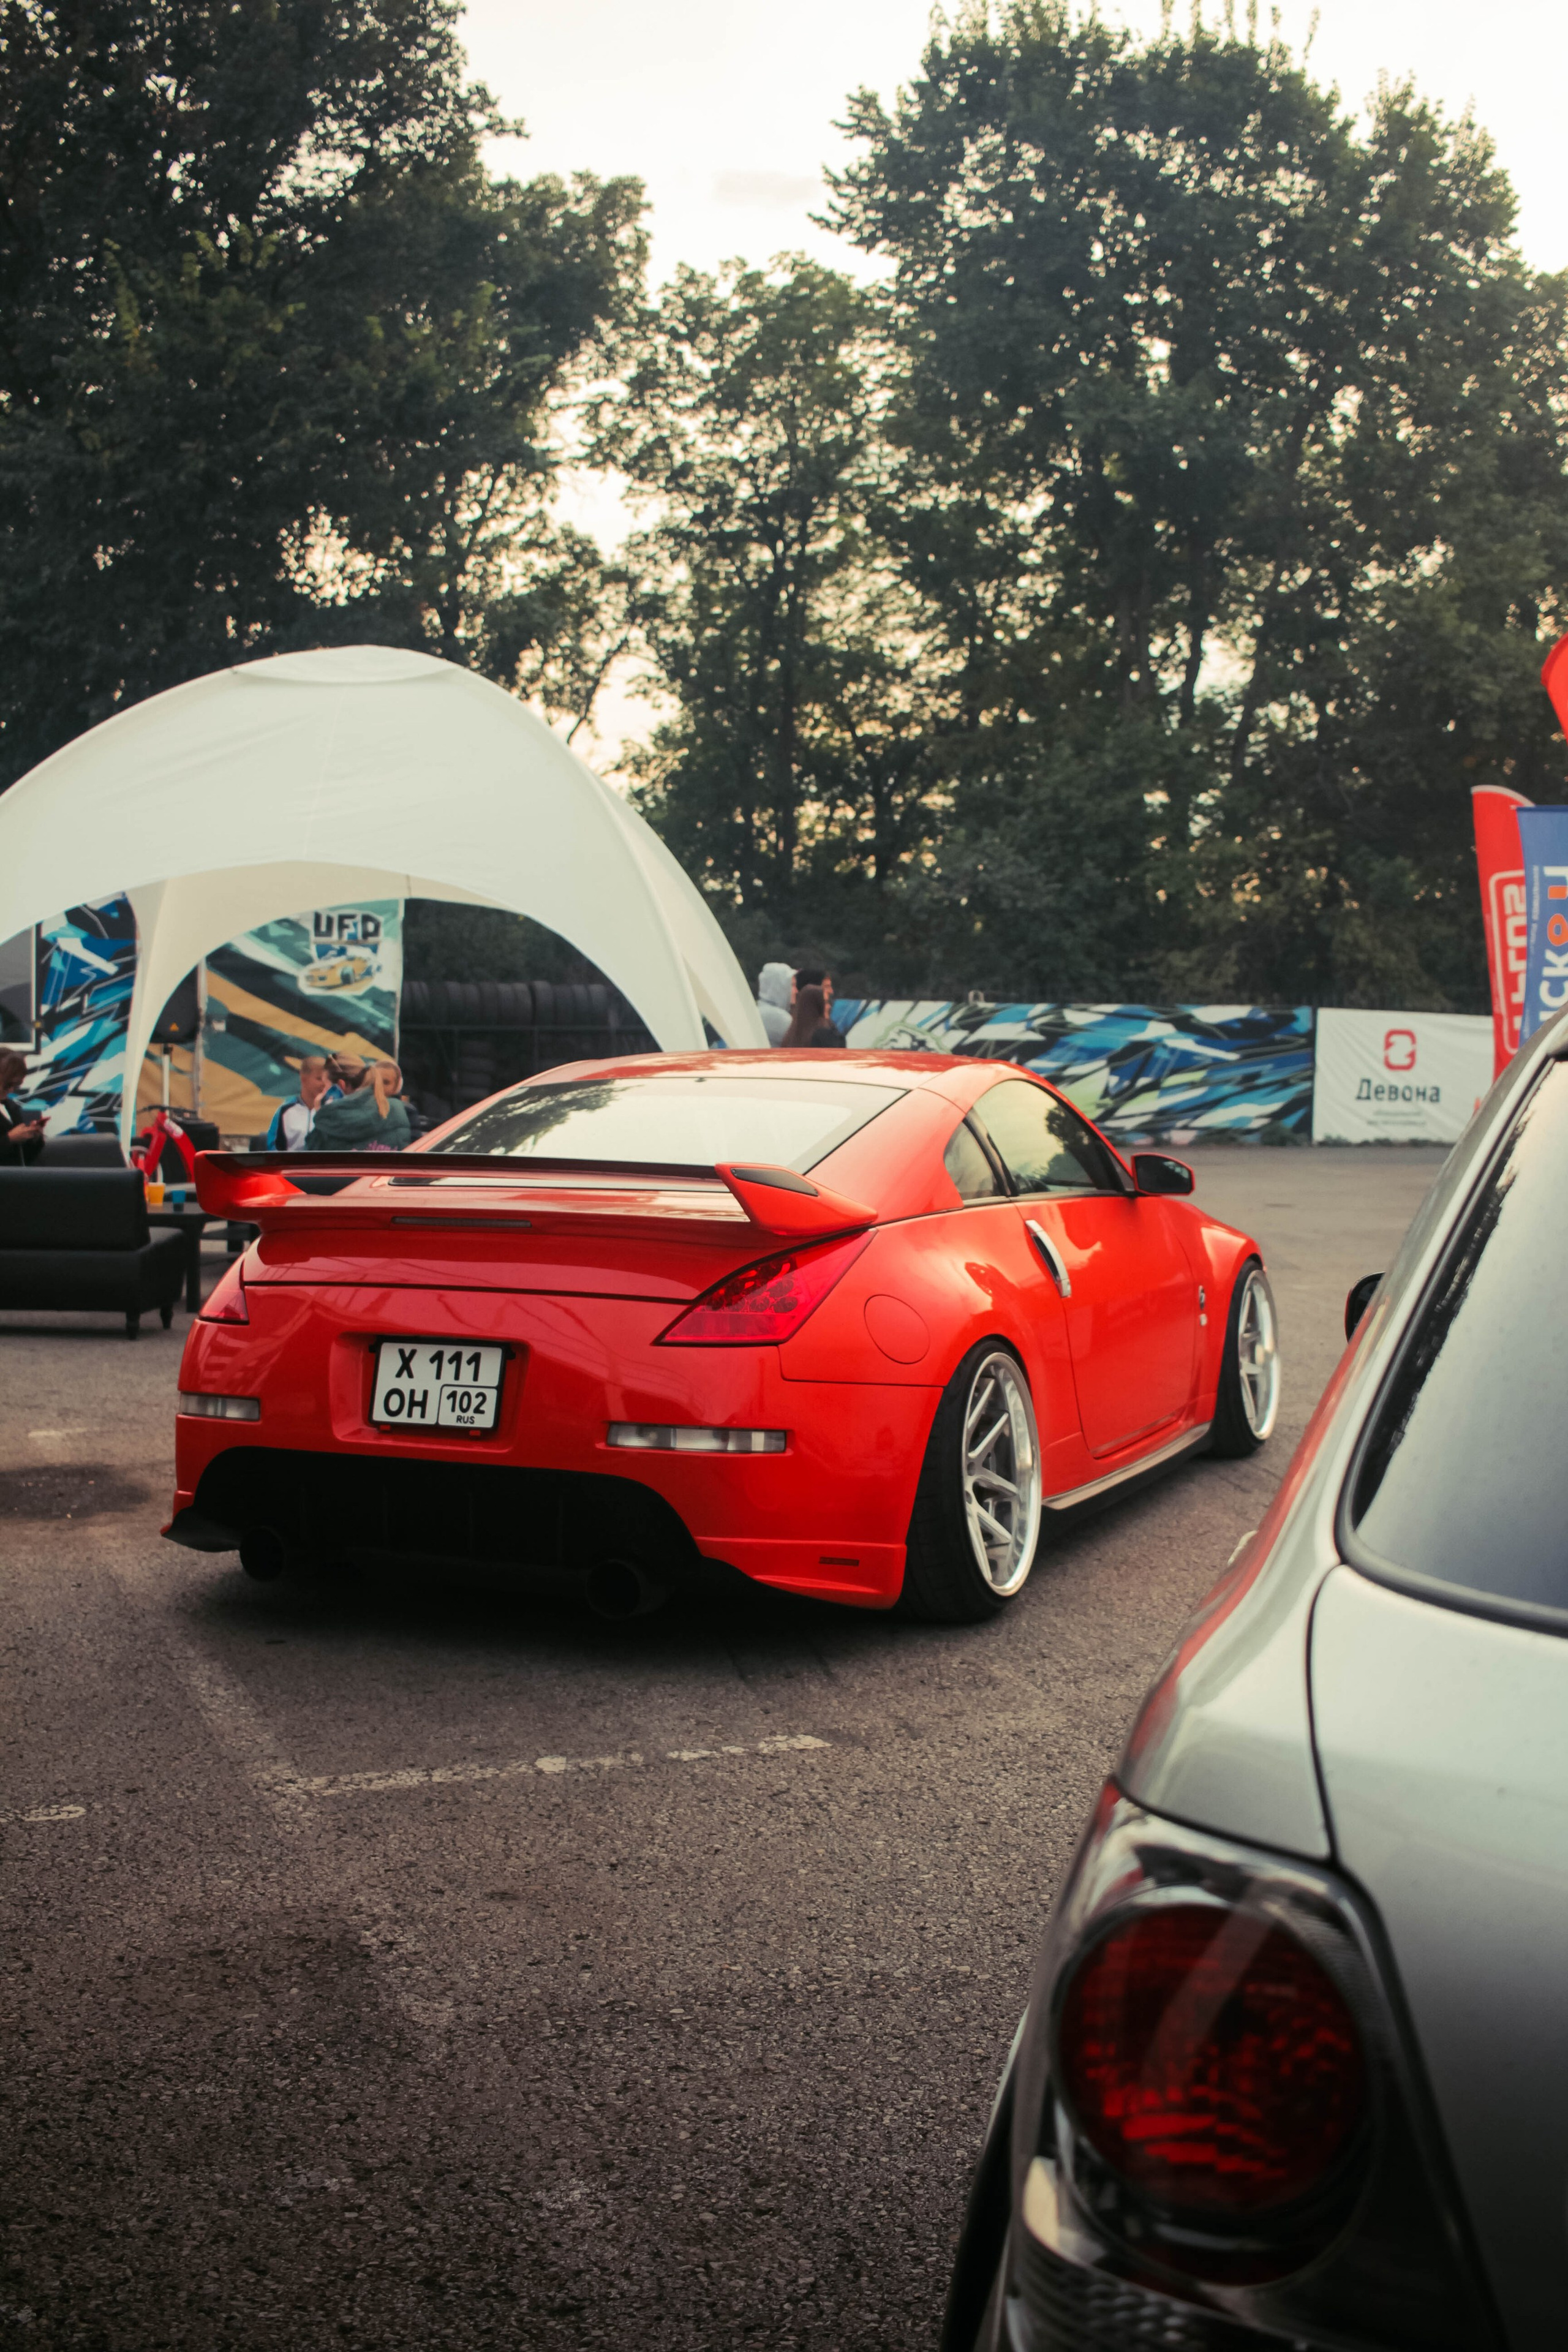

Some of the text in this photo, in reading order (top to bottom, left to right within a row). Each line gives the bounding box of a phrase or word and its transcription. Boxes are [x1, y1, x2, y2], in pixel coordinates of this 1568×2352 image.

[1355, 1078, 1441, 1103] Девона
[395, 1348, 481, 1382] Х 111
[383, 1388, 487, 1419] ОН 102
[456, 1415, 475, 1425] RUS
